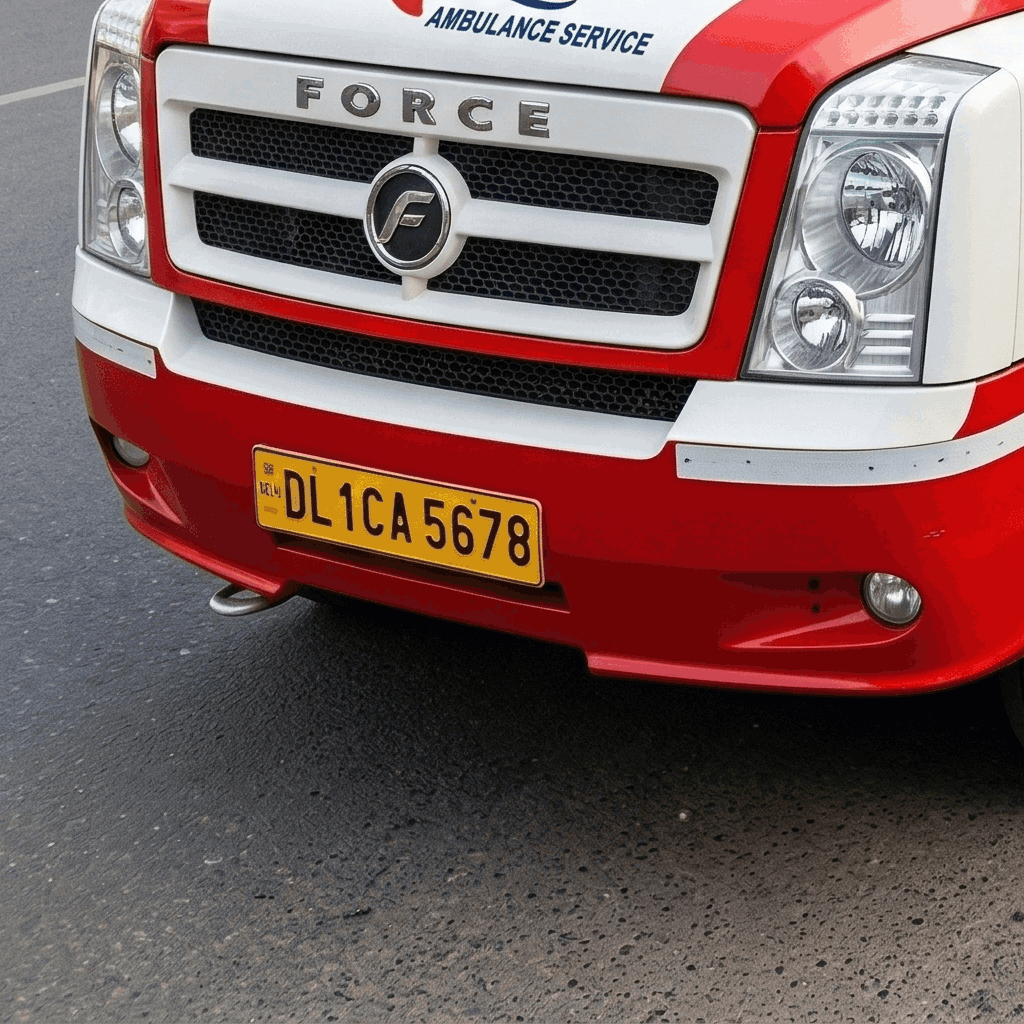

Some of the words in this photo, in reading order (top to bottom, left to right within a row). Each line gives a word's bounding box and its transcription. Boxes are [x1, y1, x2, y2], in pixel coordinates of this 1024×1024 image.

[424, 6, 560, 43] AMBULANCE
[558, 22, 654, 56] SERVICE
[296, 75, 550, 139] FORCE
[283, 468, 412, 544] DL1CA
[423, 497, 531, 567] 5678
